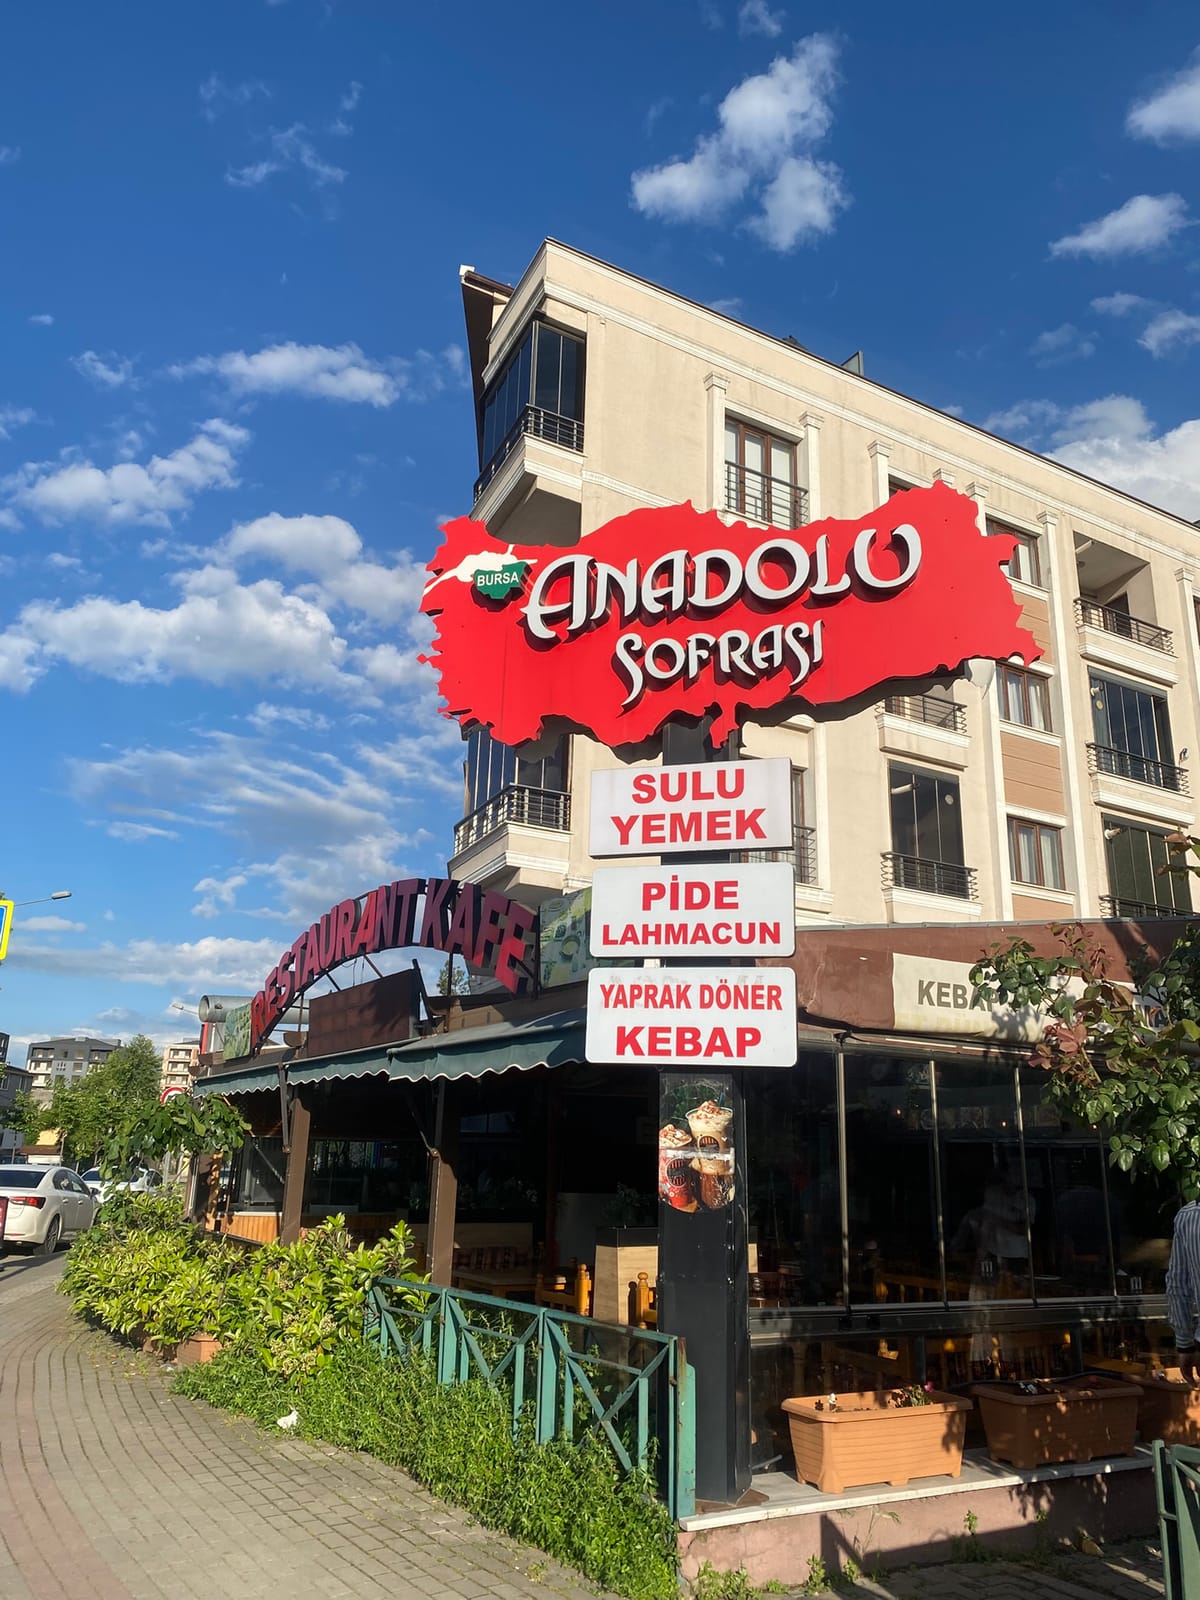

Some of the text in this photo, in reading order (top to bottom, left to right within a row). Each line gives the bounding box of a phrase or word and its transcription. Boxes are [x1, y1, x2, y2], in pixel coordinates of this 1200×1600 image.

[477, 571, 519, 586] BURSA
[519, 524, 922, 640] ANADOLU
[615, 620, 823, 706] SOFRASI
[631, 768, 745, 804] SULU
[610, 808, 767, 846] YEMEK
[642, 874, 739, 911] PİDE
[602, 921, 781, 946] LAHMACUN
[250, 878, 536, 1050] RESTAURANT KAFE
[599, 979, 782, 1011] YAPRAK DÖNER
[616, 1026, 762, 1058] KEBAP
